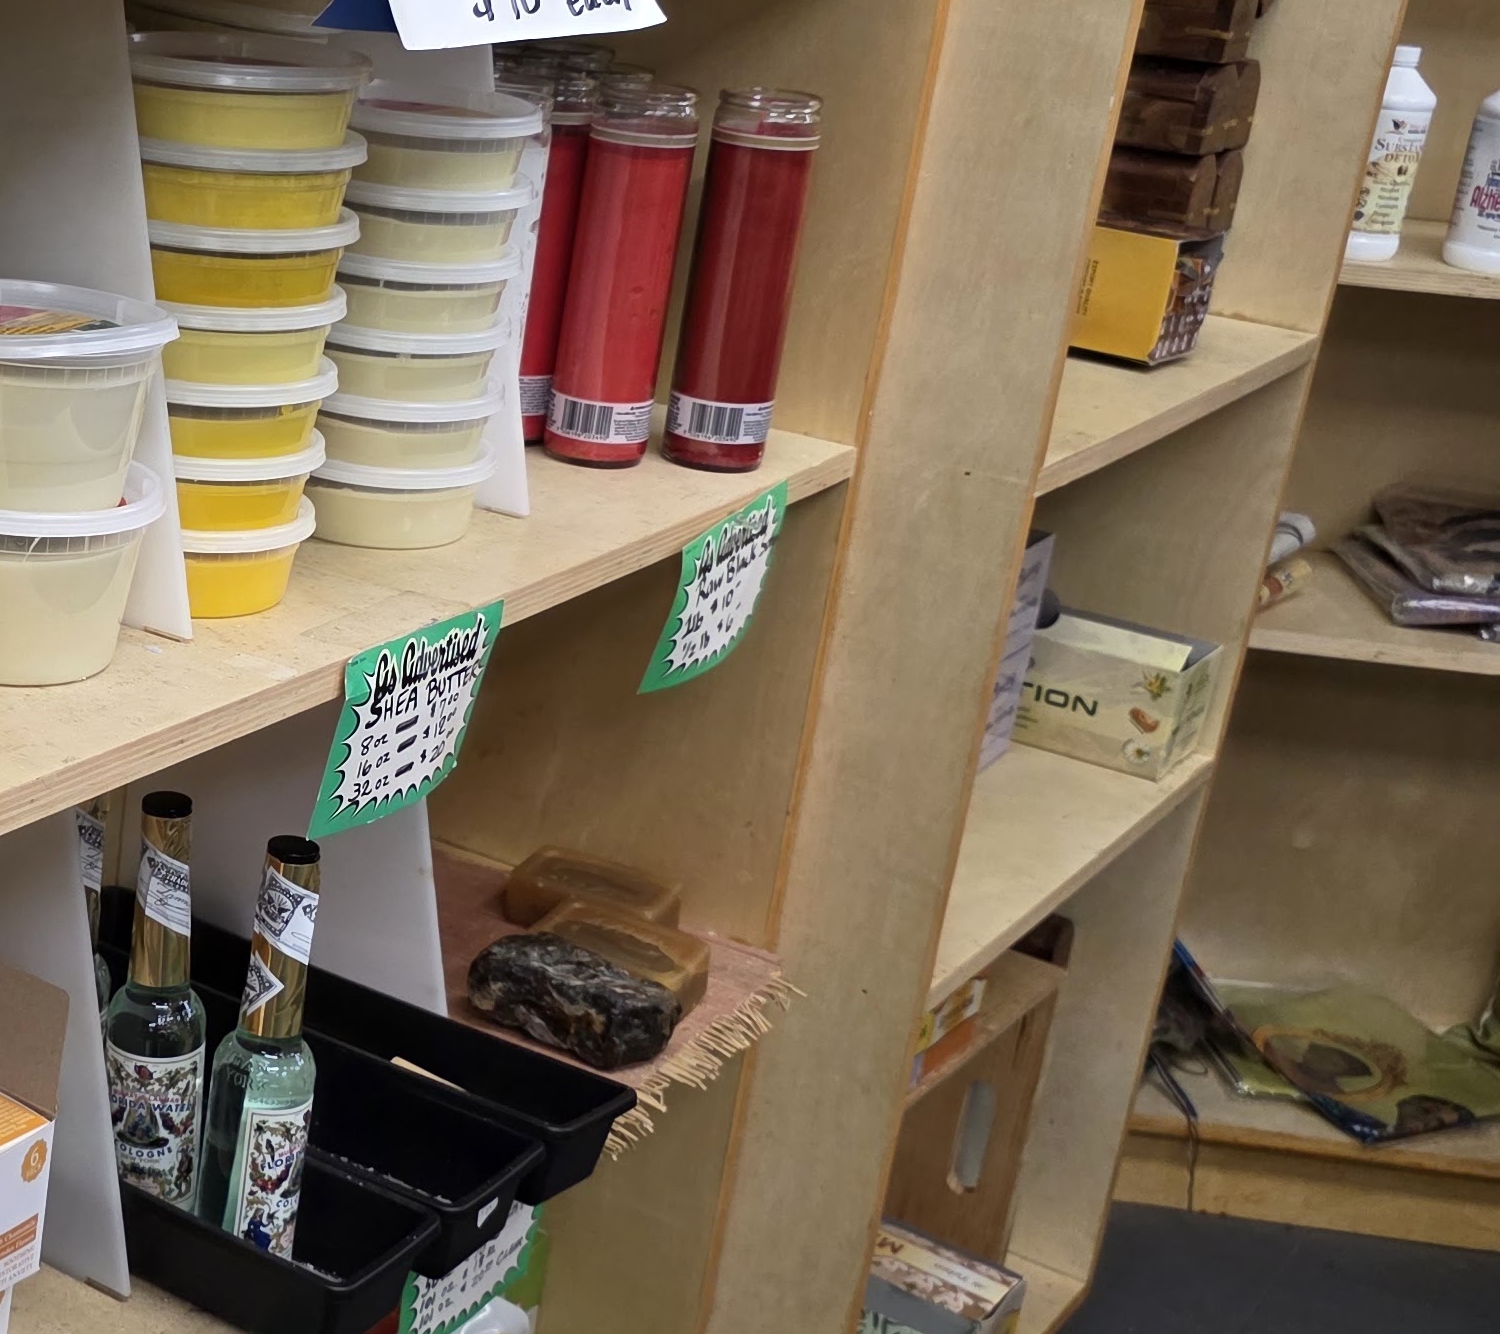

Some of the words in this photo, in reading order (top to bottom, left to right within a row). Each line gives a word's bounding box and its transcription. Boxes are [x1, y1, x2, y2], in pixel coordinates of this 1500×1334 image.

[401, 617, 484, 690] Advertised
[364, 686, 419, 730] SHEA
[426, 659, 479, 706] BUTTER
[347, 779, 373, 803] 32
[29, 1146, 40, 1167] 6
